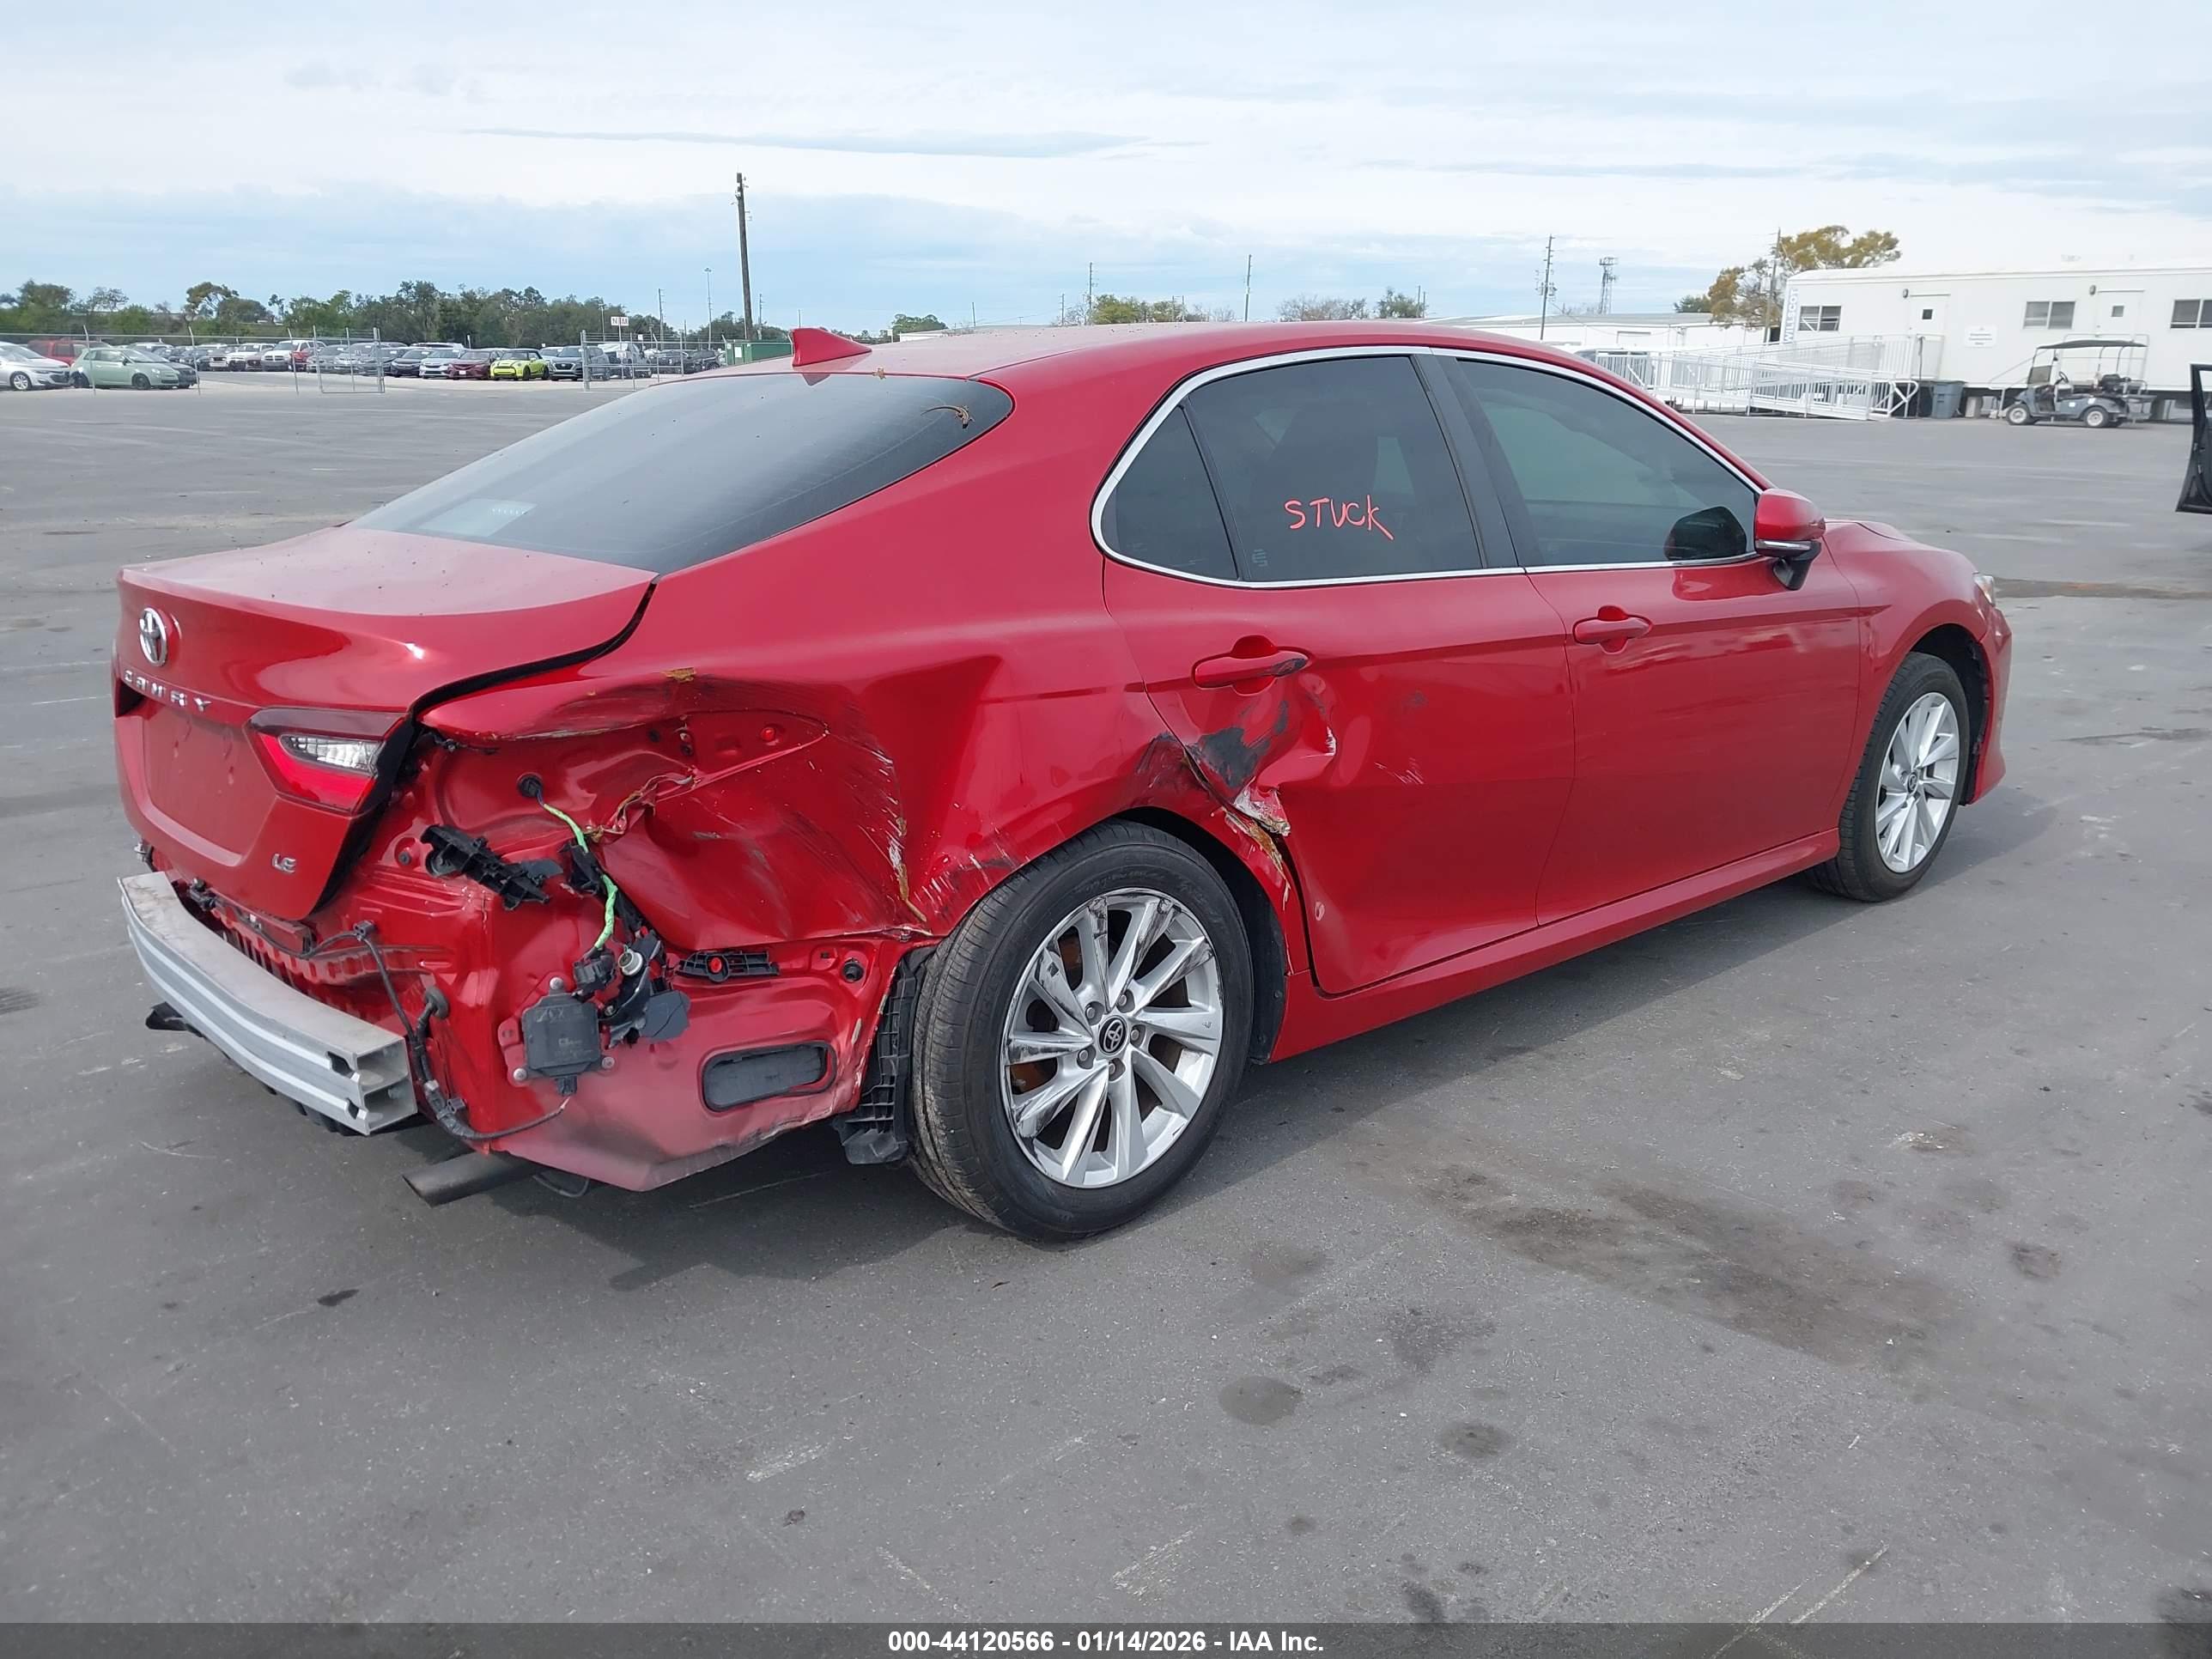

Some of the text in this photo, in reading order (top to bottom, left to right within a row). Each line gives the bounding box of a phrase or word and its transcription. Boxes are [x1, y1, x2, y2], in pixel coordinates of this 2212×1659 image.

[1784, 289, 1799, 343] WILLSCOT
[125, 670, 212, 712] CAMRY
[271, 853, 296, 873] LE
